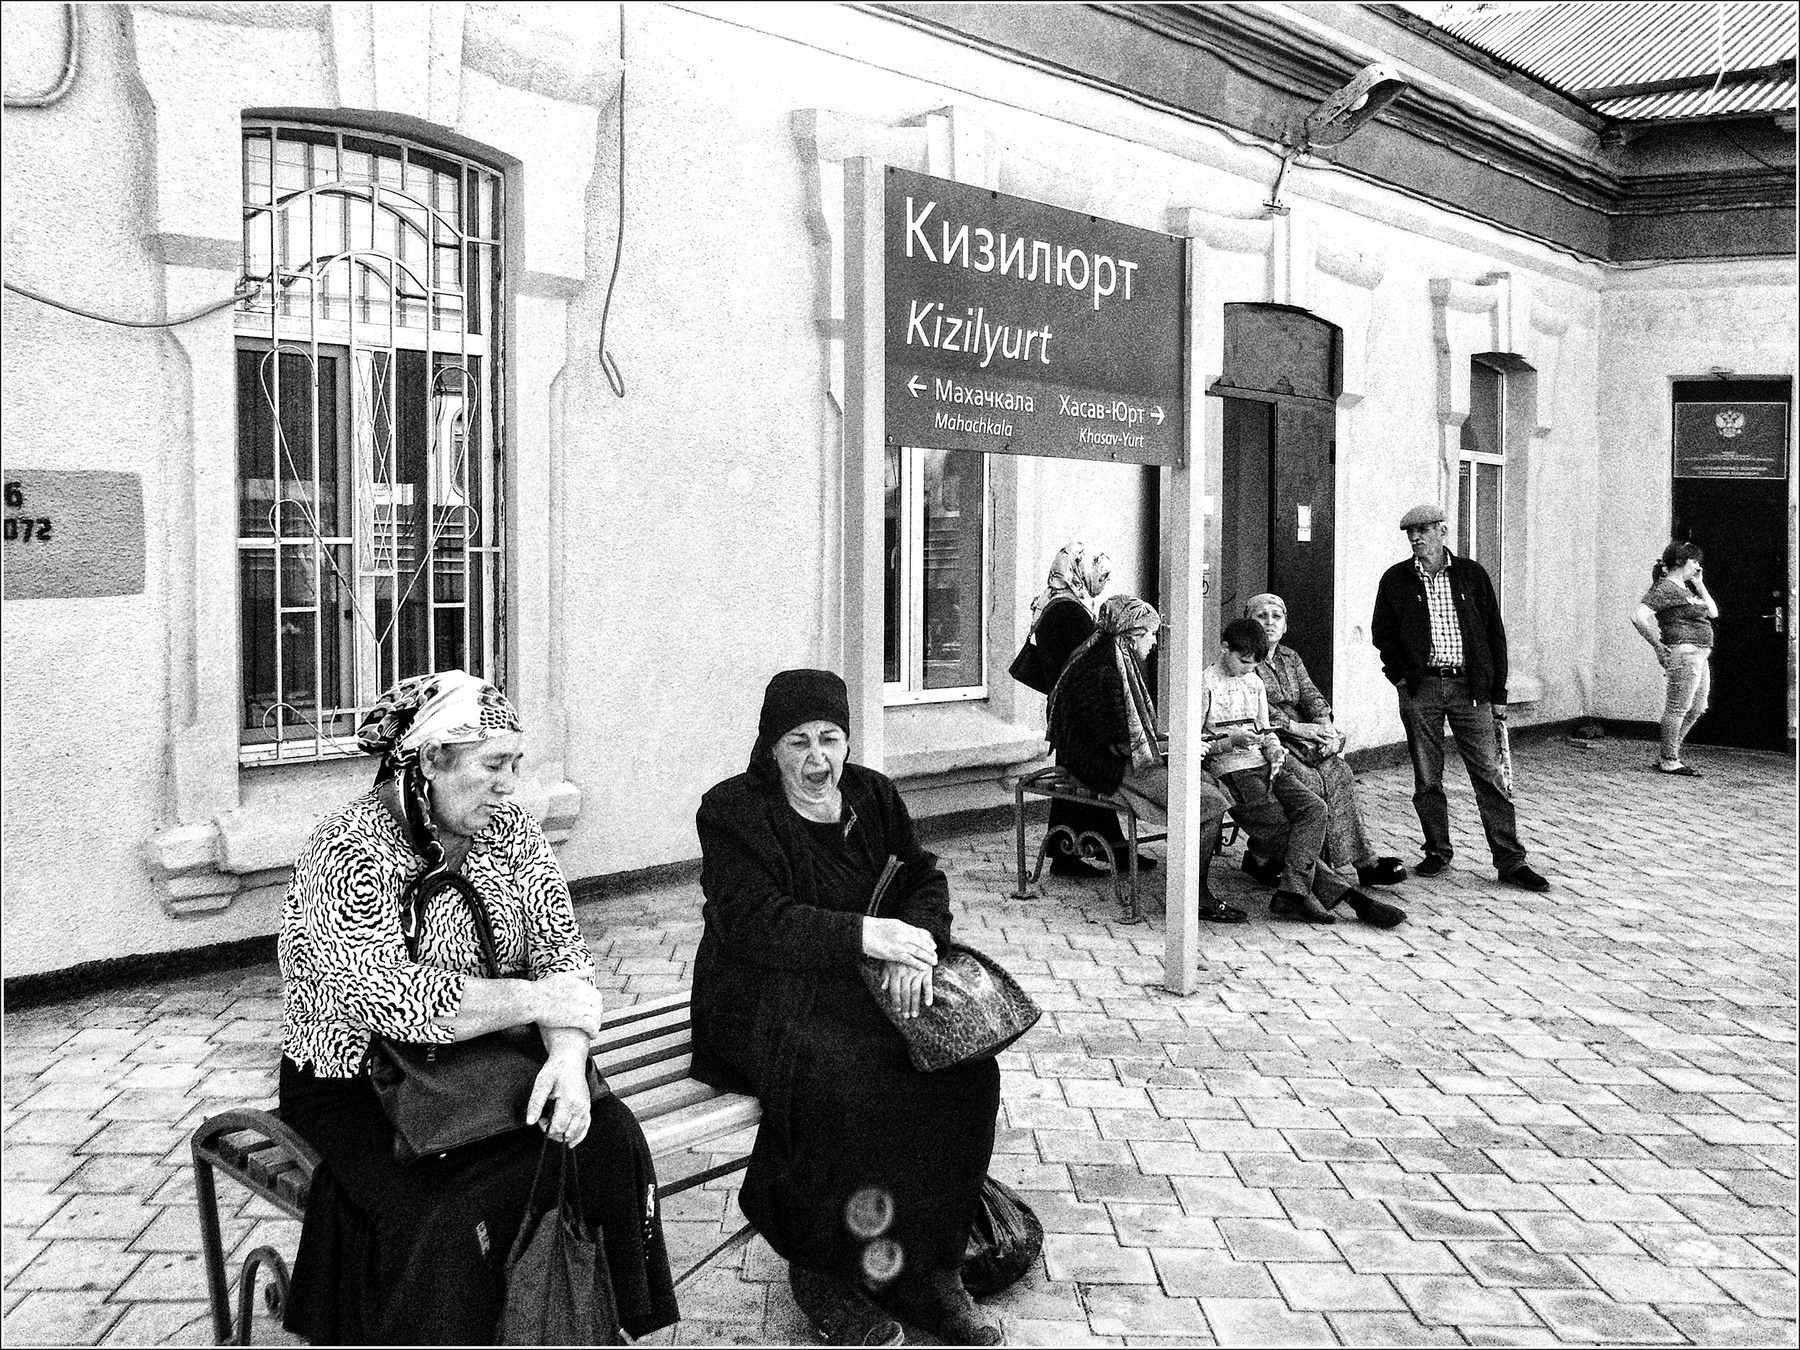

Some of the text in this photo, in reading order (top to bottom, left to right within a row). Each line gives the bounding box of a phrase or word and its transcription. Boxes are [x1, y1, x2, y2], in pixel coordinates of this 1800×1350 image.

[906, 196, 1139, 311] Кизилюрт
[906, 300, 1053, 368] Kizilyurt
[935, 378, 1034, 413] Махачкала
[1059, 394, 1145, 428] Хасав-Юрт
[934, 412, 1013, 437] Mahachkala
[1079, 427, 1144, 448] Khasav-Yurt
